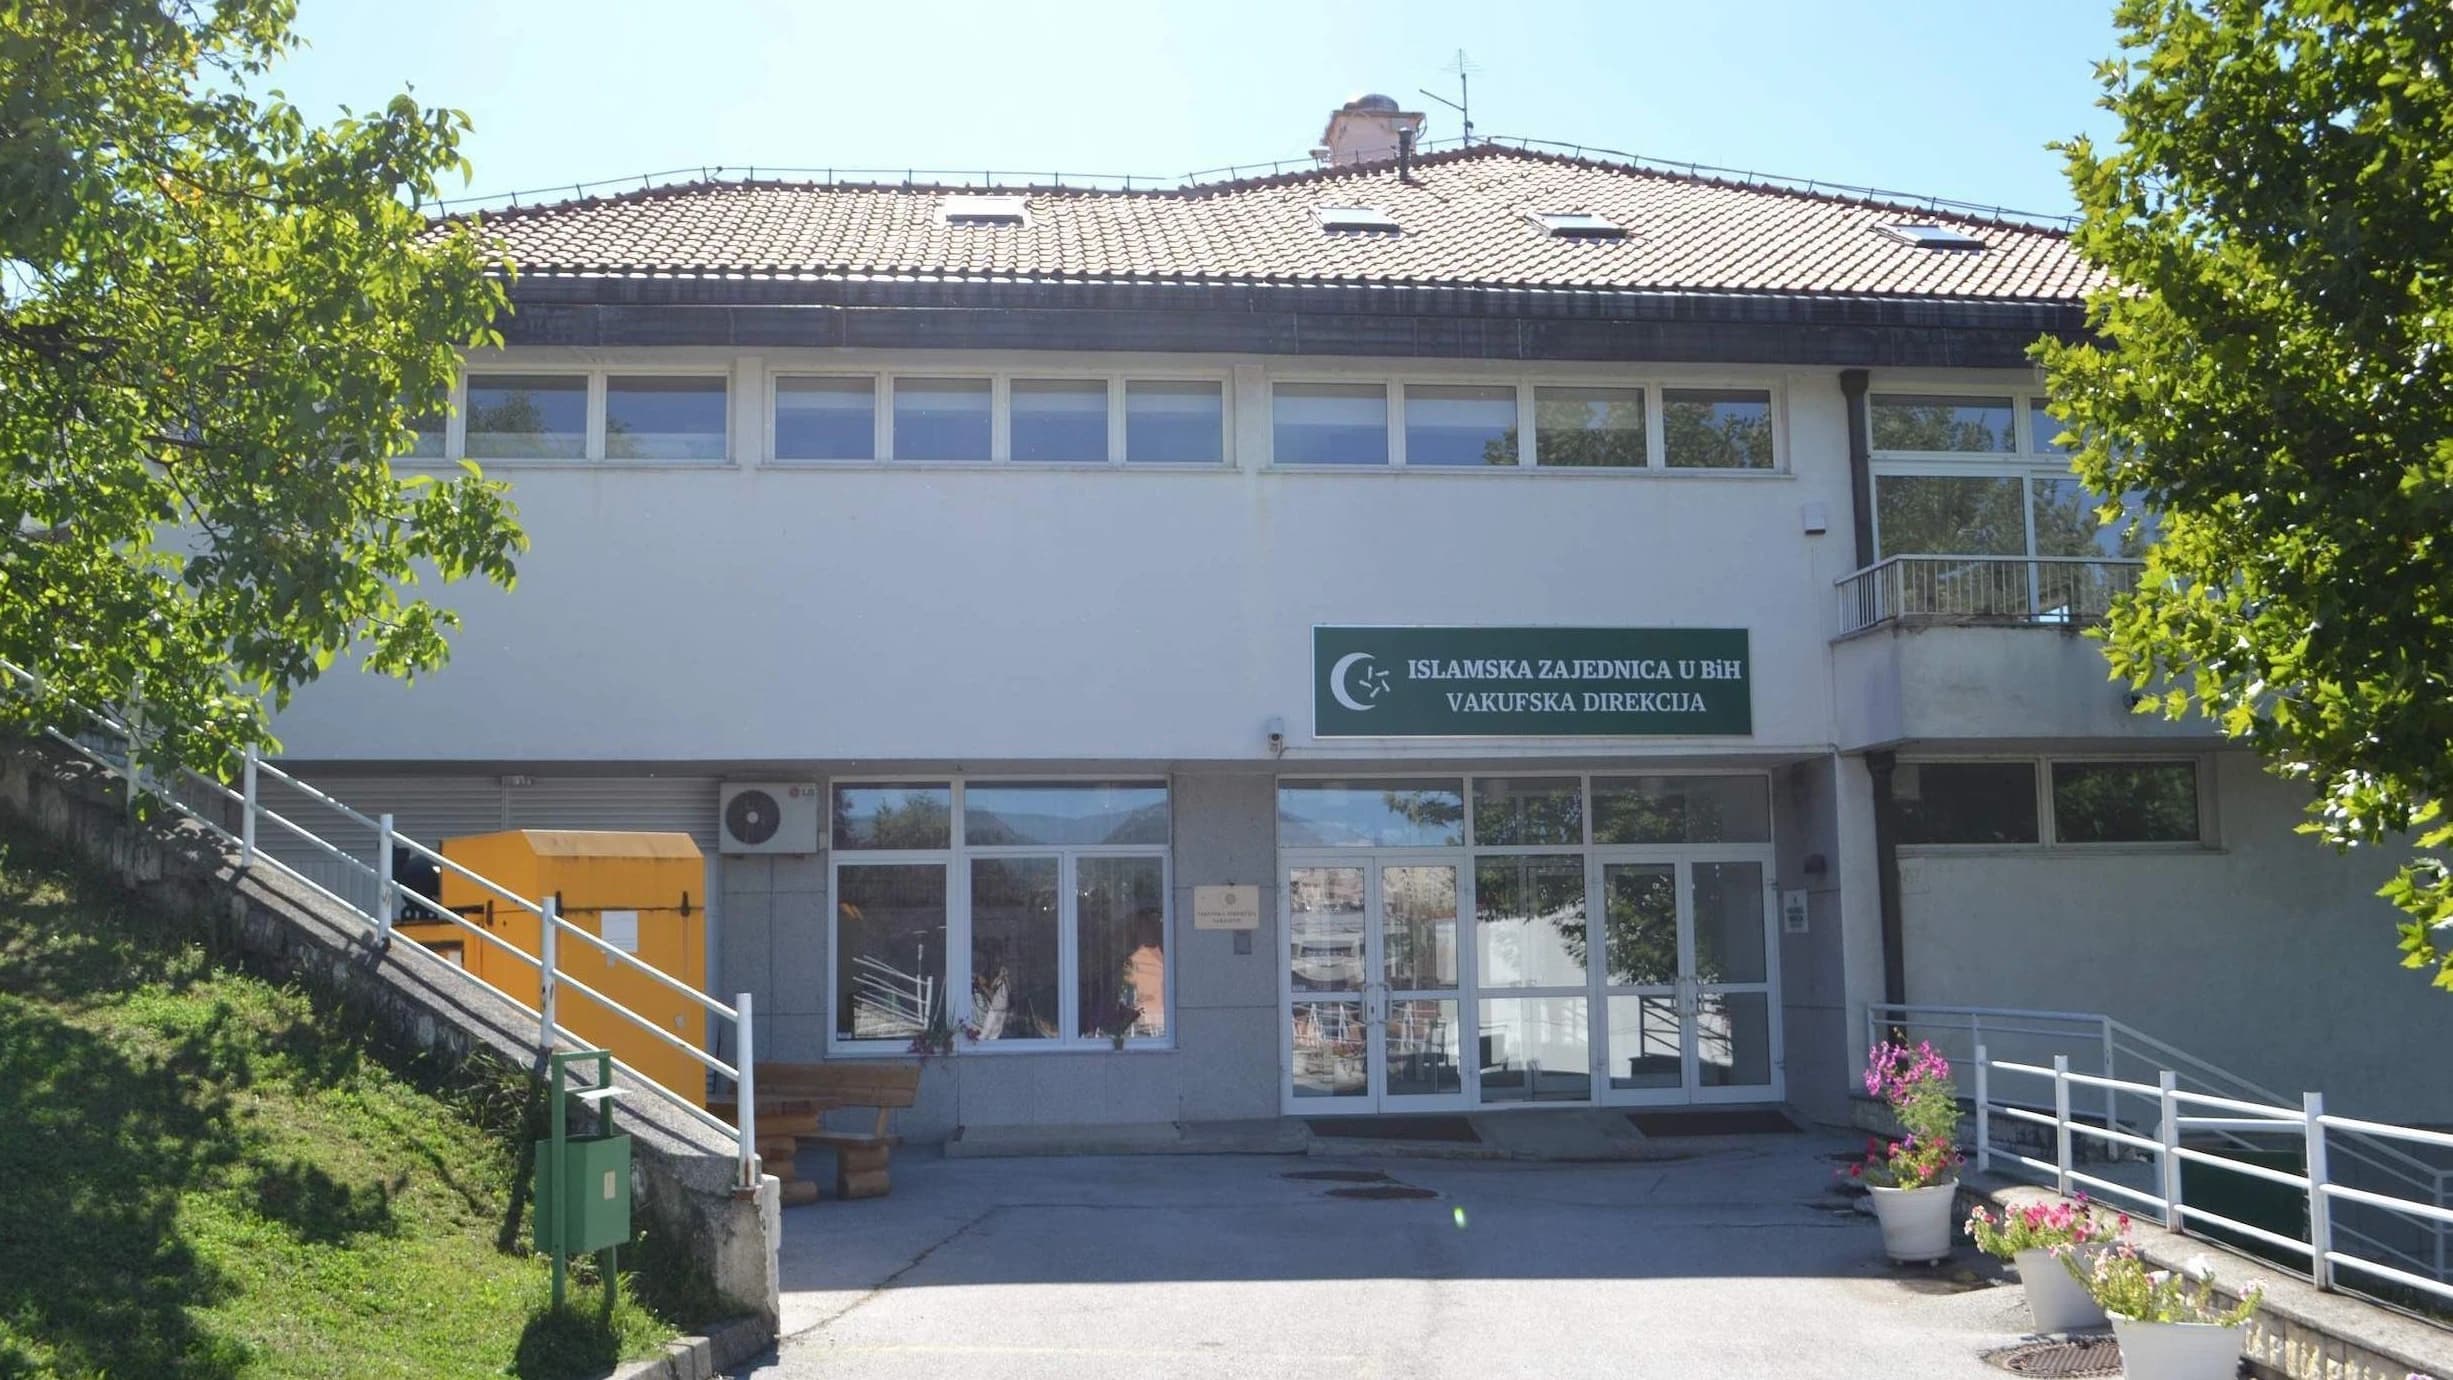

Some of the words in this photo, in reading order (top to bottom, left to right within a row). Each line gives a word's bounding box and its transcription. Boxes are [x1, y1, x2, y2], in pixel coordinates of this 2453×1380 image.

[1408, 659, 1534, 679] ISLAMSKA
[1538, 659, 1673, 679] ZAJEDNICA
[1678, 659, 1696, 679] U
[1700, 659, 1742, 680] BiH
[1446, 692, 1577, 712] VAKUFSKA
[1583, 692, 1707, 712] DIREKCIJA
